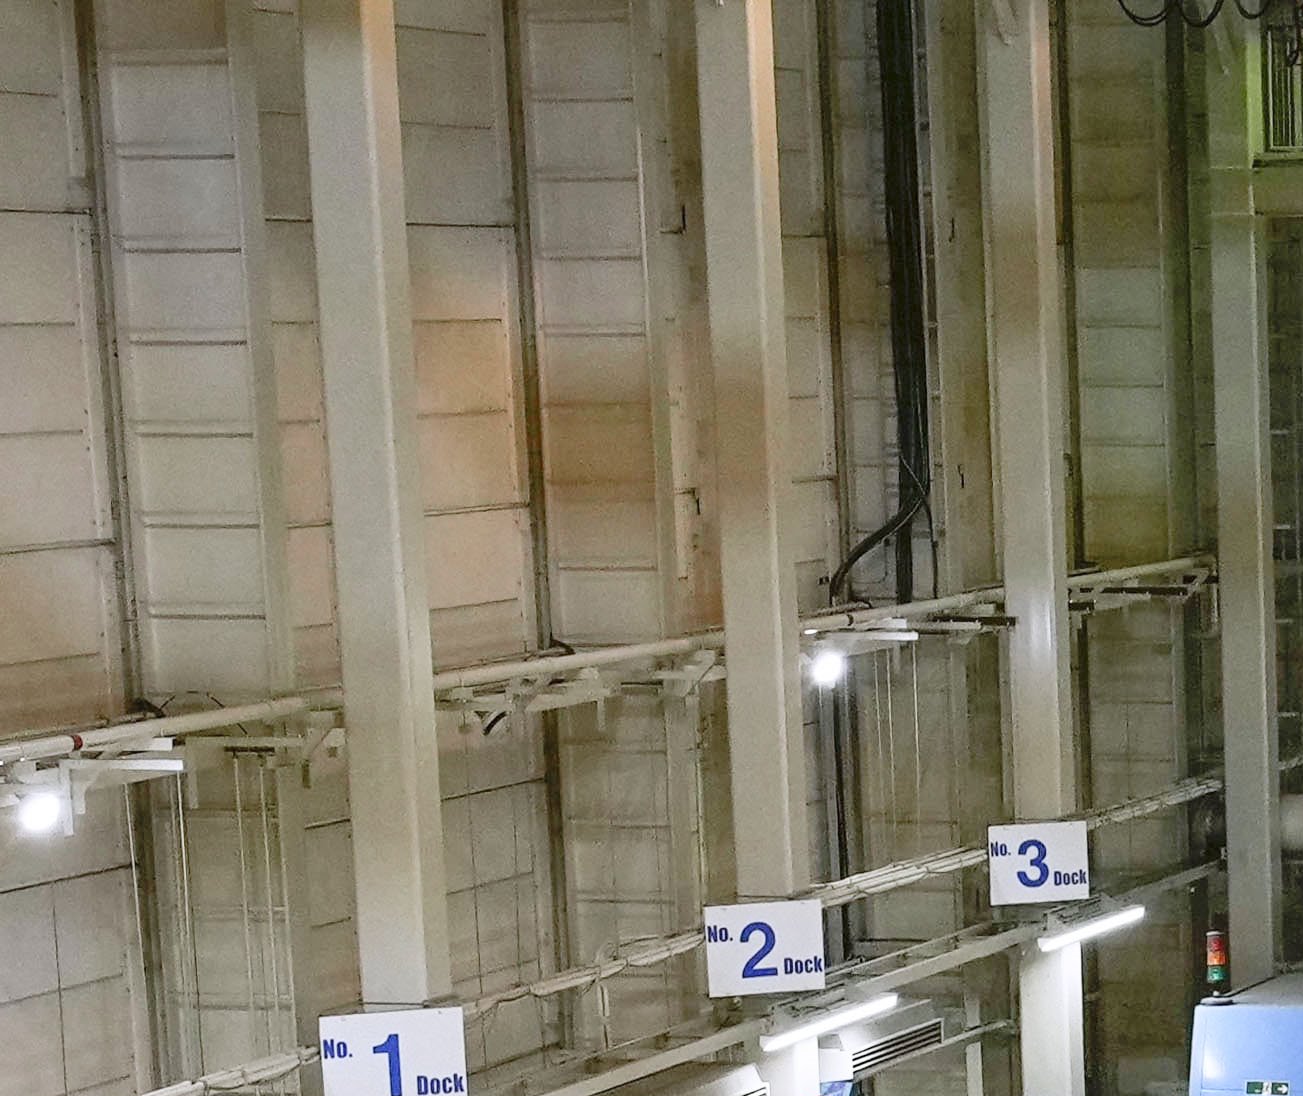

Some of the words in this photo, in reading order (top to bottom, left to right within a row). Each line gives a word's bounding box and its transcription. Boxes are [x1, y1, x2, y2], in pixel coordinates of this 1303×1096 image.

[990, 841, 1011, 857] No.
[1017, 839, 1049, 888] 3
[1054, 869, 1087, 886] Dock
[707, 925, 733, 943] No.
[740, 922, 778, 978] 2
[784, 956, 823, 975] Dock
[323, 1039, 353, 1059] No.
[417, 1073, 464, 1096] Dock
